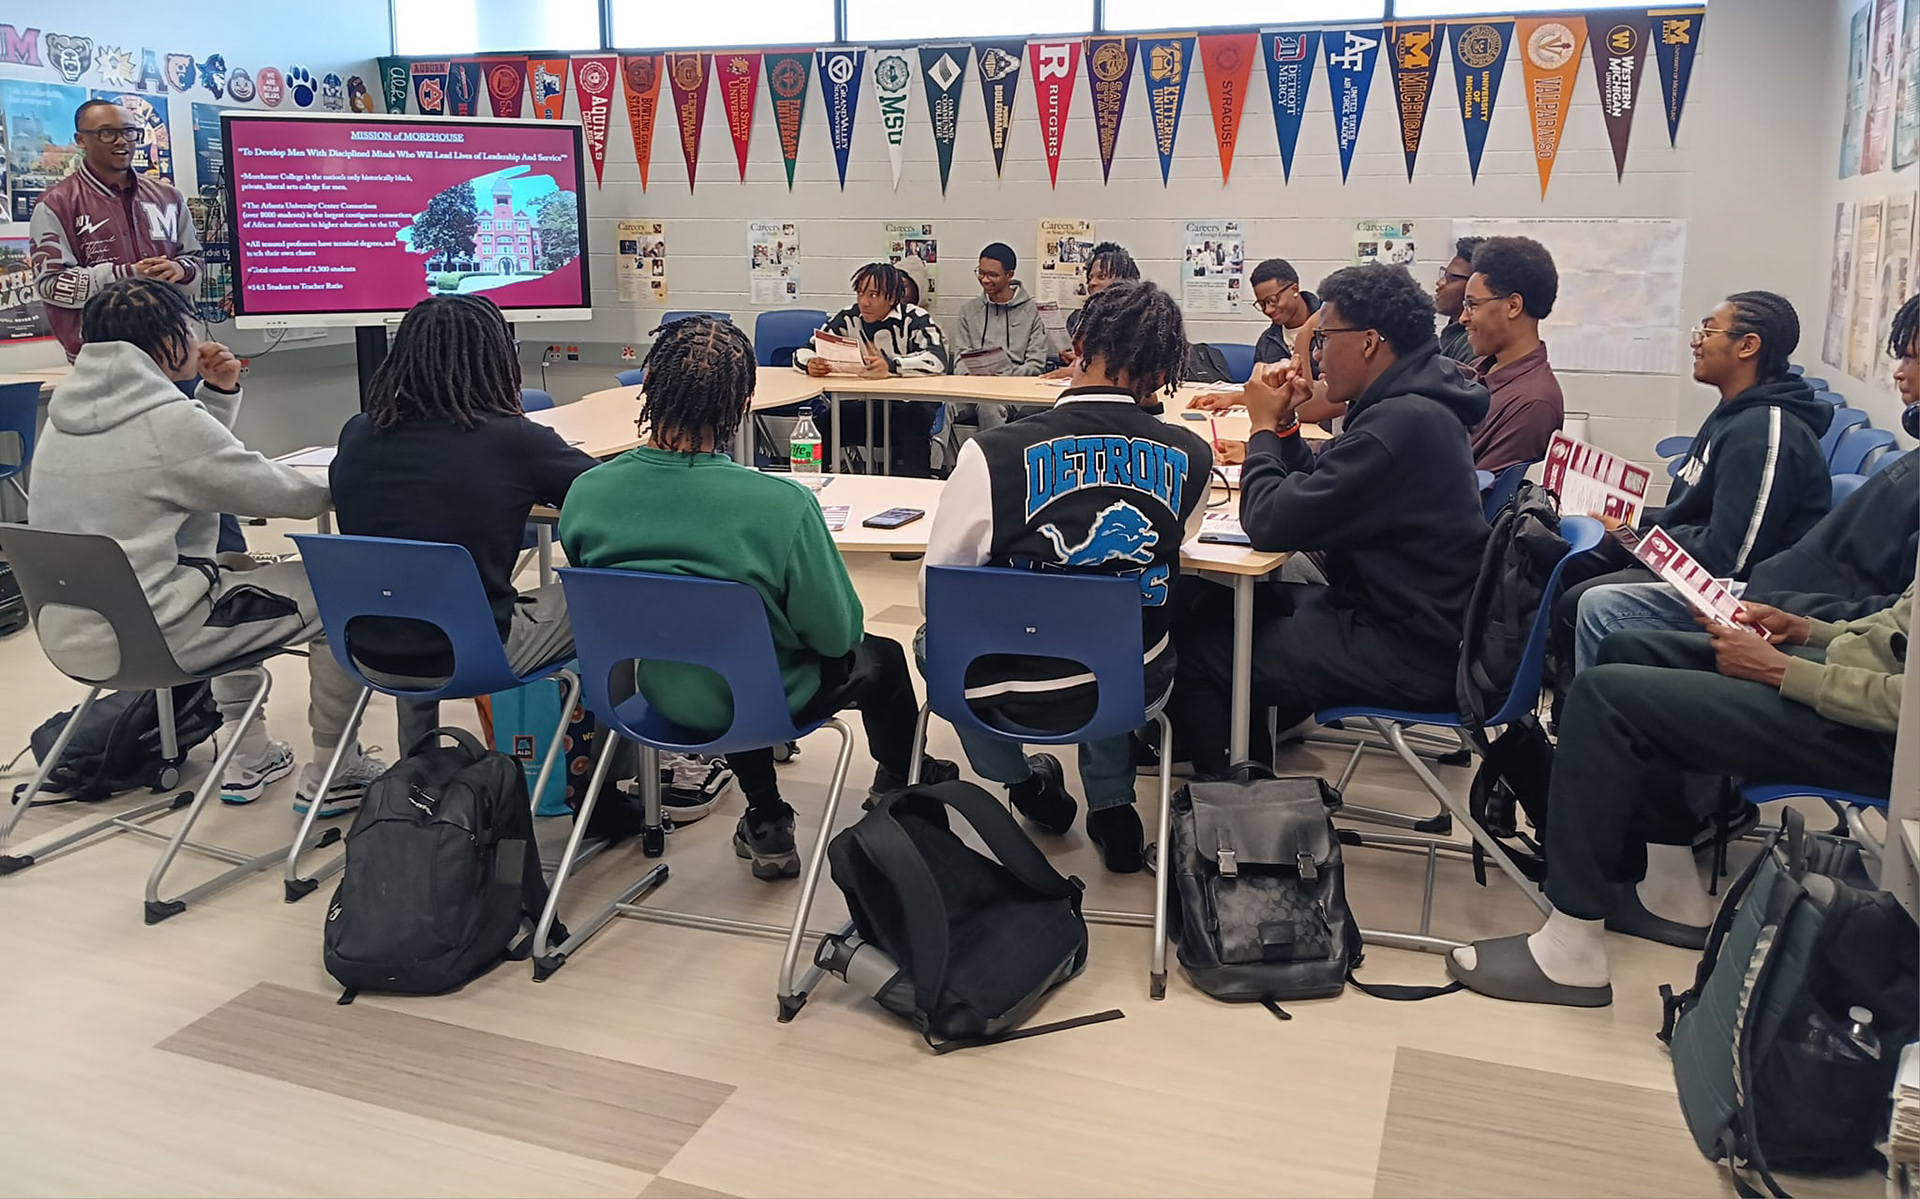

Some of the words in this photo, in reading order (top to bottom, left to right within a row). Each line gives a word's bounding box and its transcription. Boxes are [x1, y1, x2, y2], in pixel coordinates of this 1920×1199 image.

[1611, 30, 1630, 50] W
[413, 63, 446, 73] AUBURN
[1039, 43, 1070, 82] R
[740, 76, 751, 110] FERRIS
[1109, 81, 1123, 111] SAN
[1278, 64, 1288, 107] MERCY
[1287, 64, 1298, 116] DETROIT
[1343, 77, 1351, 89] AIR
[1464, 75, 1474, 119] MICHIGAN
[1474, 90, 1481, 103] OF
[1479, 71, 1490, 123] UNIVERSITY
[1608, 57, 1622, 118] MICHIGAN
[1620, 55, 1635, 109] WESTERN
[628, 95, 641, 120] STATE
[641, 97, 654, 132] BOWLING
[728, 79, 741, 138] UNIVERSITY
[840, 83, 849, 118] GRAND
[994, 84, 1004, 149] BOILERMAKERS
[1096, 81, 1109, 126] STATE
[1221, 80, 1233, 148] SYRACUSE
[1342, 90, 1350, 115] FORCE
[1349, 86, 1358, 113] UNITED
[1398, 72, 1428, 152] MICHIGAN
[582, 110, 595, 145] COLLEGE
[592, 95, 608, 161] AQUINAS
[741, 111, 750, 141] STATE
[841, 117, 849, 150] VALLEY
[879, 94, 907, 146] MSU
[941, 93, 949, 145] COMMUNITY
[1048, 84, 1059, 157] RUTGERS
[1152, 88, 1166, 154] UNIVERSITY
[1163, 85, 1180, 155] KETTERING
[1340, 116, 1349, 152] ACADEMY
[1348, 114, 1357, 140] STATES
[1533, 75, 1563, 160] VALPARAISO
[351, 131, 392, 140] MISSION
[393, 131, 403, 141] of
[403, 132, 464, 142] MOREHOUSE
[255, 148, 286, 158] Develop
[288, 149, 305, 157] Men
[307, 149, 327, 157] With
[329, 149, 370, 159] Disciplined
[372, 150, 395, 158] Minds
[398, 151, 416, 159] Who
[417, 151, 433, 159] Will
[454, 152, 472, 160] Lives
[474, 152, 482, 160] of
[482, 152, 520, 162] Leadership
[522, 153, 537, 161] And
[280, 173, 304, 181] College
[347, 173, 360, 182] only
[361, 173, 394, 183] historically
[299, 183, 320, 192] college
[140, 201, 179, 244] M
[285, 202, 317, 211] University
[324, 211, 344, 220] largest
[318, 221, 338, 229] higher
[617, 222, 646, 231] Careers
[750, 222, 781, 232] Careers
[885, 223, 915, 232] Careers
[1041, 220, 1075, 230] Careers
[1185, 223, 1220, 232] Careers
[1356, 222, 1395, 231] Careers
[250, 240, 261, 248] All
[286, 240, 317, 249] professors
[1024, 434, 1188, 526] DETROIT
